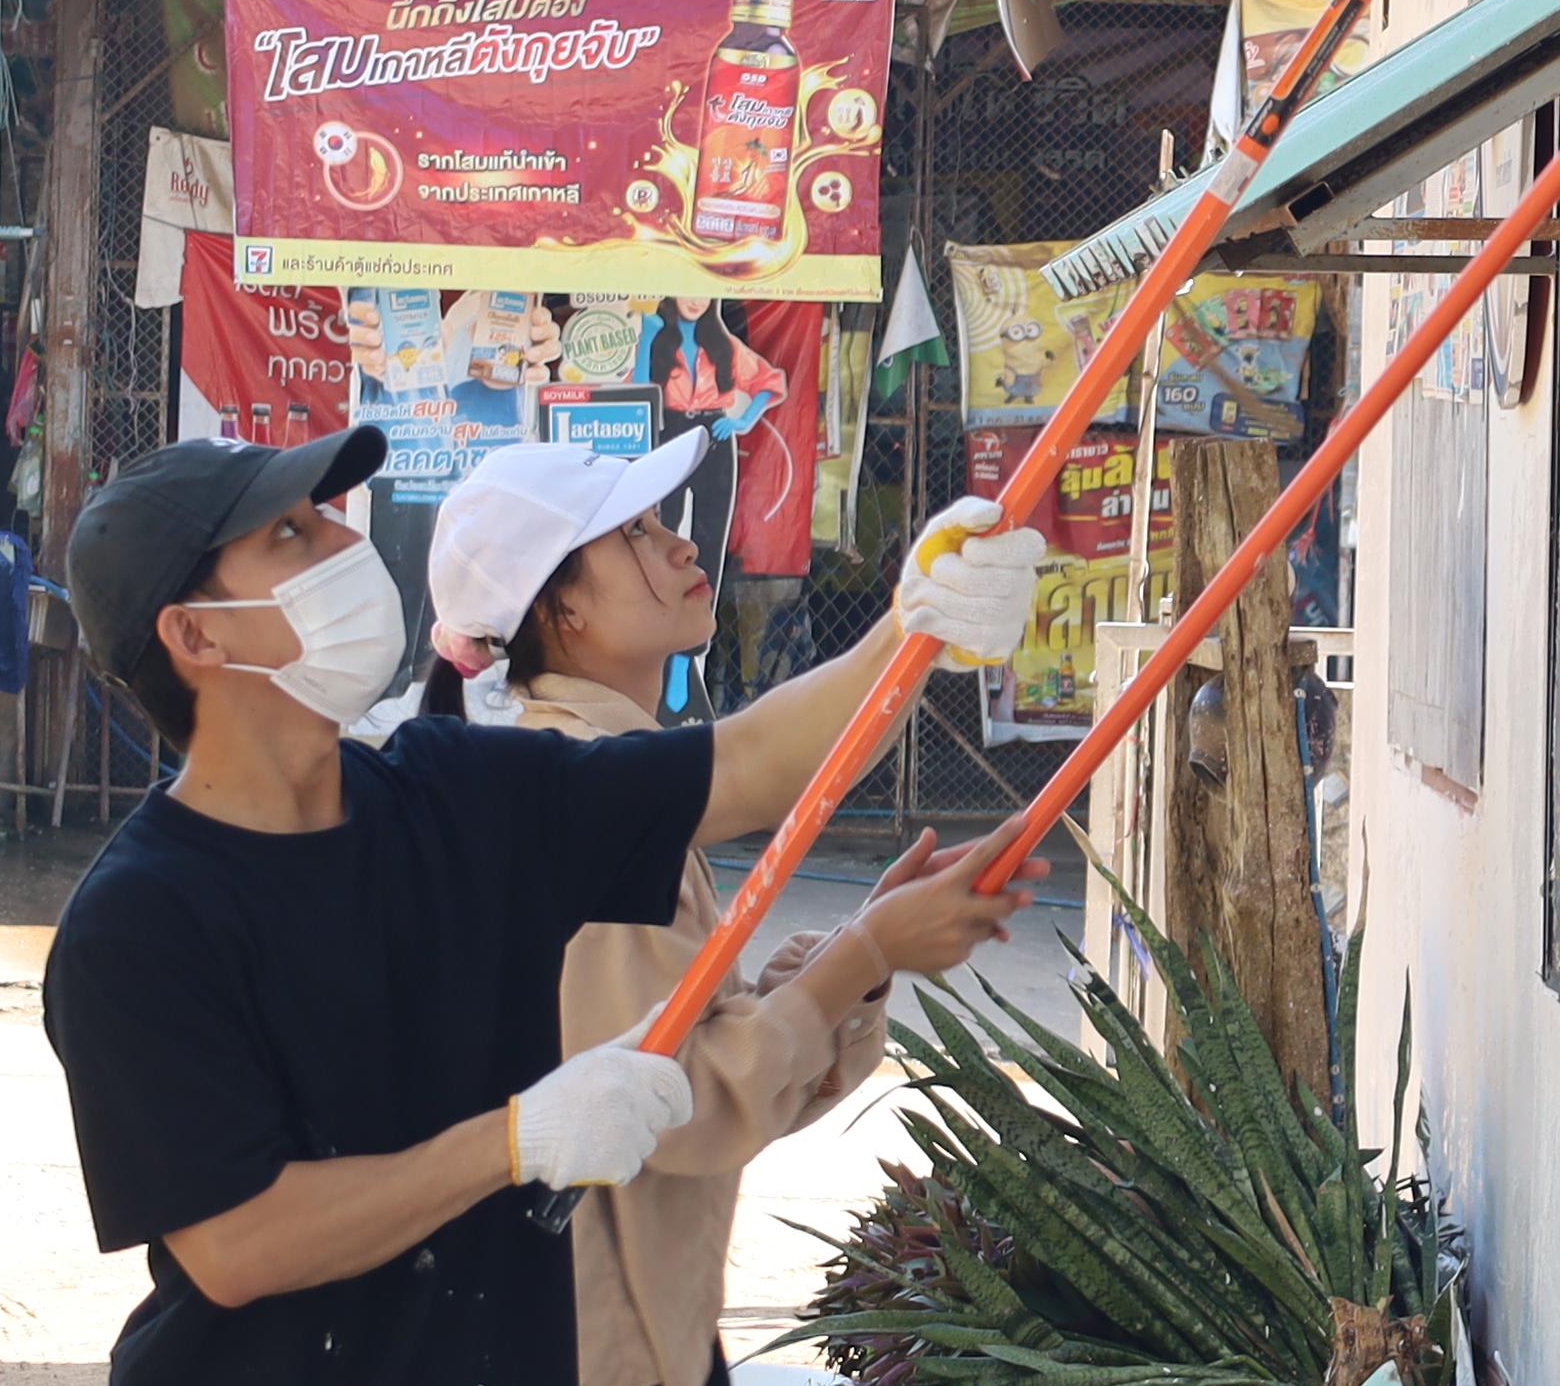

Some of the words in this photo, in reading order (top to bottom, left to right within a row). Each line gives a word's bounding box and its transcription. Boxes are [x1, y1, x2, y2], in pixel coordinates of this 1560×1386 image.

[418, 150, 566, 172] รากโสมแท้นำเข้า
[418, 183, 580, 204] จากประเทศเกาหลี
[282, 254, 452, 277] และร้านค้าตู้แช่ทั่วประเทศ
[269, 300, 350, 344] พร้อ
[564, 335, 598, 359] PLANT
[600, 326, 636, 350] BASED
[543, 390, 586, 400] SOYMILK
[1164, 387, 1197, 403] 160
[556, 412, 645, 448] Lactasoy
